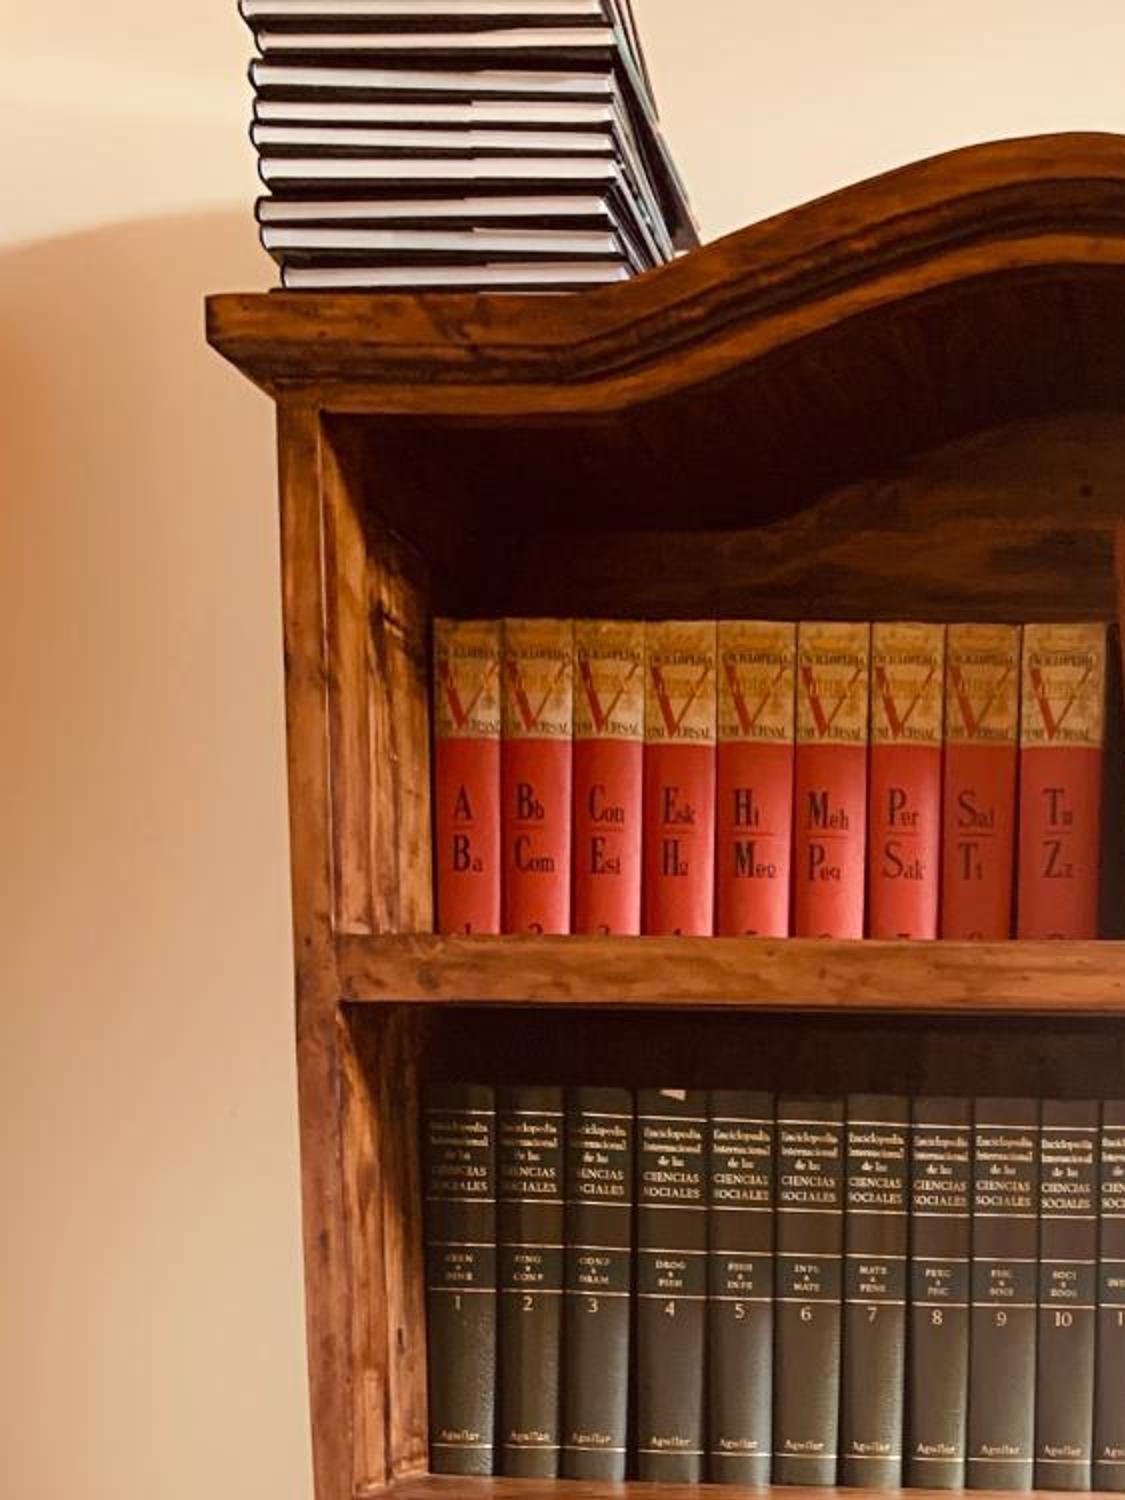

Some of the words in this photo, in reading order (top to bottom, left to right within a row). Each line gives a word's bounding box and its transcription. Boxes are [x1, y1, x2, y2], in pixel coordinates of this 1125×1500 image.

[454, 784, 473, 820] A
[453, 836, 483, 872] Ba
[514, 836, 554, 873] Com
[883, 842, 923, 879] Sak
[644, 1172, 699, 1183] CIENCIAS
[714, 1174, 769, 1185] CIENCIAS
[782, 1176, 835, 1187] CIENCIAS
[850, 1177, 901, 1188] CIENCIAS
[914, 1180, 966, 1191] CIENCIAS
[976, 1180, 1030, 1191] CIENCIAS
[1042, 1183, 1090, 1193] CIENCIAS
[455, 1295, 461, 1310] 1
[523, 1297, 533, 1311] 2
[589, 1299, 598, 1312] 3
[665, 1302, 675, 1316] 4
[735, 1305, 744, 1318] 5
[801, 1307, 811, 1321] 6
[868, 1307, 877, 1321] 7
[932, 1310, 943, 1325] 8
[997, 1312, 1006, 1326] 9
[1055, 1312, 1072, 1326] 10
